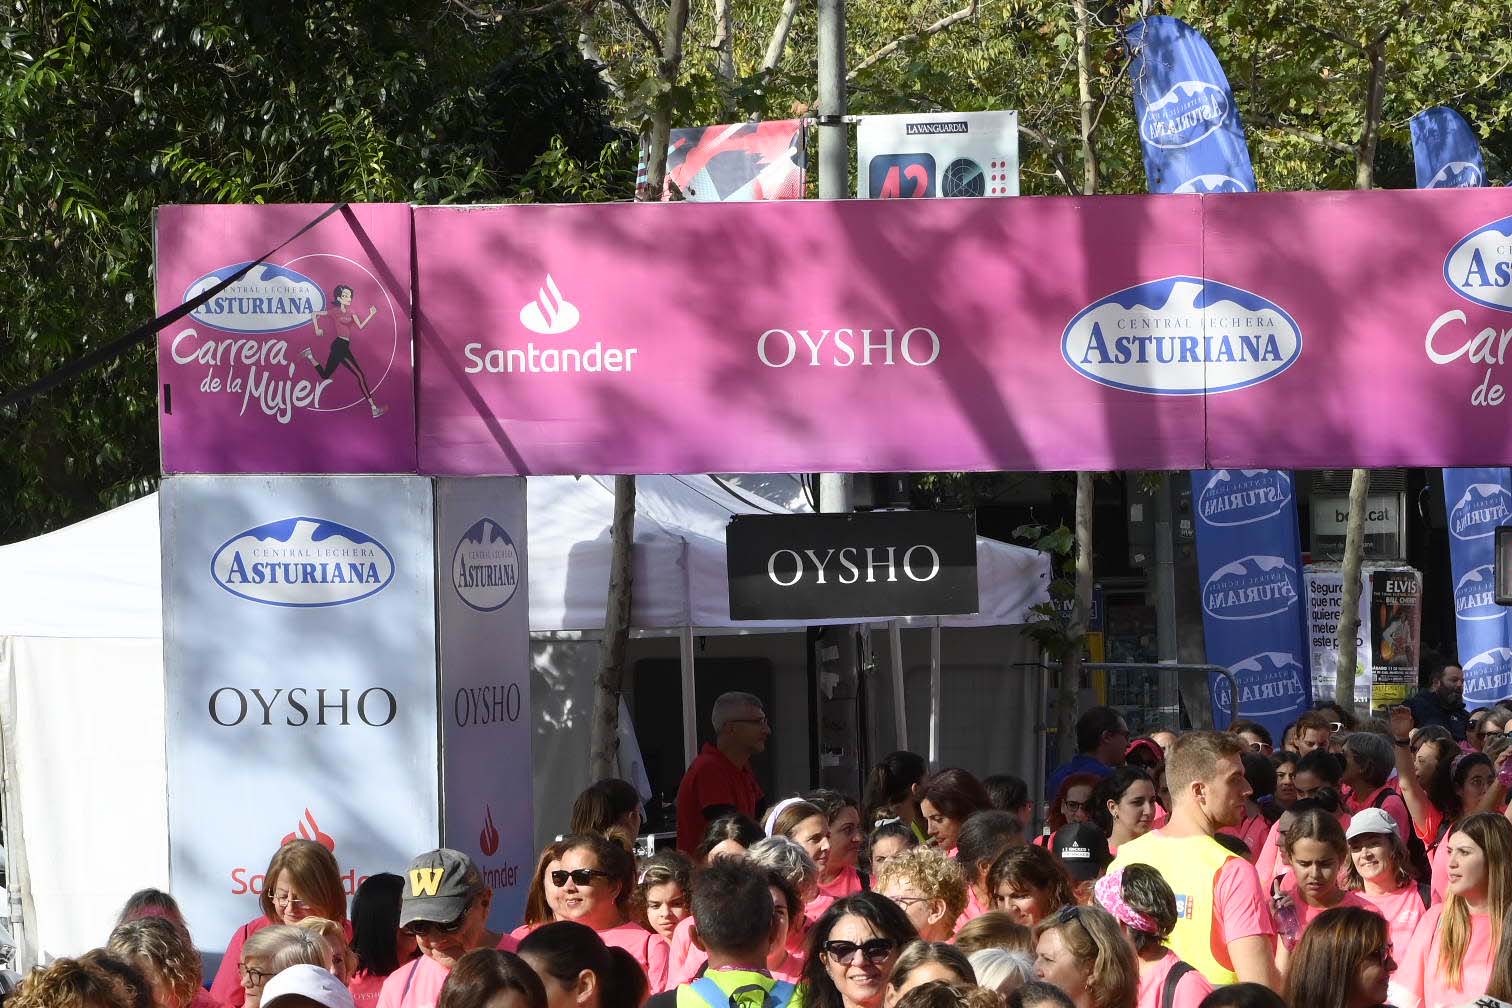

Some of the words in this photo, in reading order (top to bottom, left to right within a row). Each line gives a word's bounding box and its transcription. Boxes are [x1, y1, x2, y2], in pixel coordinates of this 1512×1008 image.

[194, 288, 314, 315] ASTURIANA
[222, 286, 258, 294] ENTRAL
[263, 286, 310, 294] LECHERA
[1117, 318, 1191, 329] CENTRAL
[1201, 317, 1275, 328] LECHERA
[171, 328, 288, 365] Carrera
[464, 342, 638, 373] Santander
[757, 327, 940, 368] OYSHO
[1080, 321, 1284, 364] ASTURIANA
[200, 368, 221, 392] de
[226, 368, 242, 392] la
[240, 361, 333, 424] Mujer
[1471, 367, 1506, 406] de
[1336, 508, 1389, 523] b.cat
[225, 551, 382, 585] ASTURIANA
[254, 548, 311, 557] CENTRAL
[317, 549, 375, 558] LECHERA
[767, 544, 940, 587] OYSHO
[457, 555, 516, 589] ASTURIANA
[1386, 580, 1417, 593] ELVIS
[1311, 597, 1328, 611] que
[1312, 610, 1344, 624] quiere
[208, 686, 397, 727] OYSHO
[454, 682, 521, 727] OYSHO
[410, 868, 445, 896] W
[483, 859, 519, 888] tander
